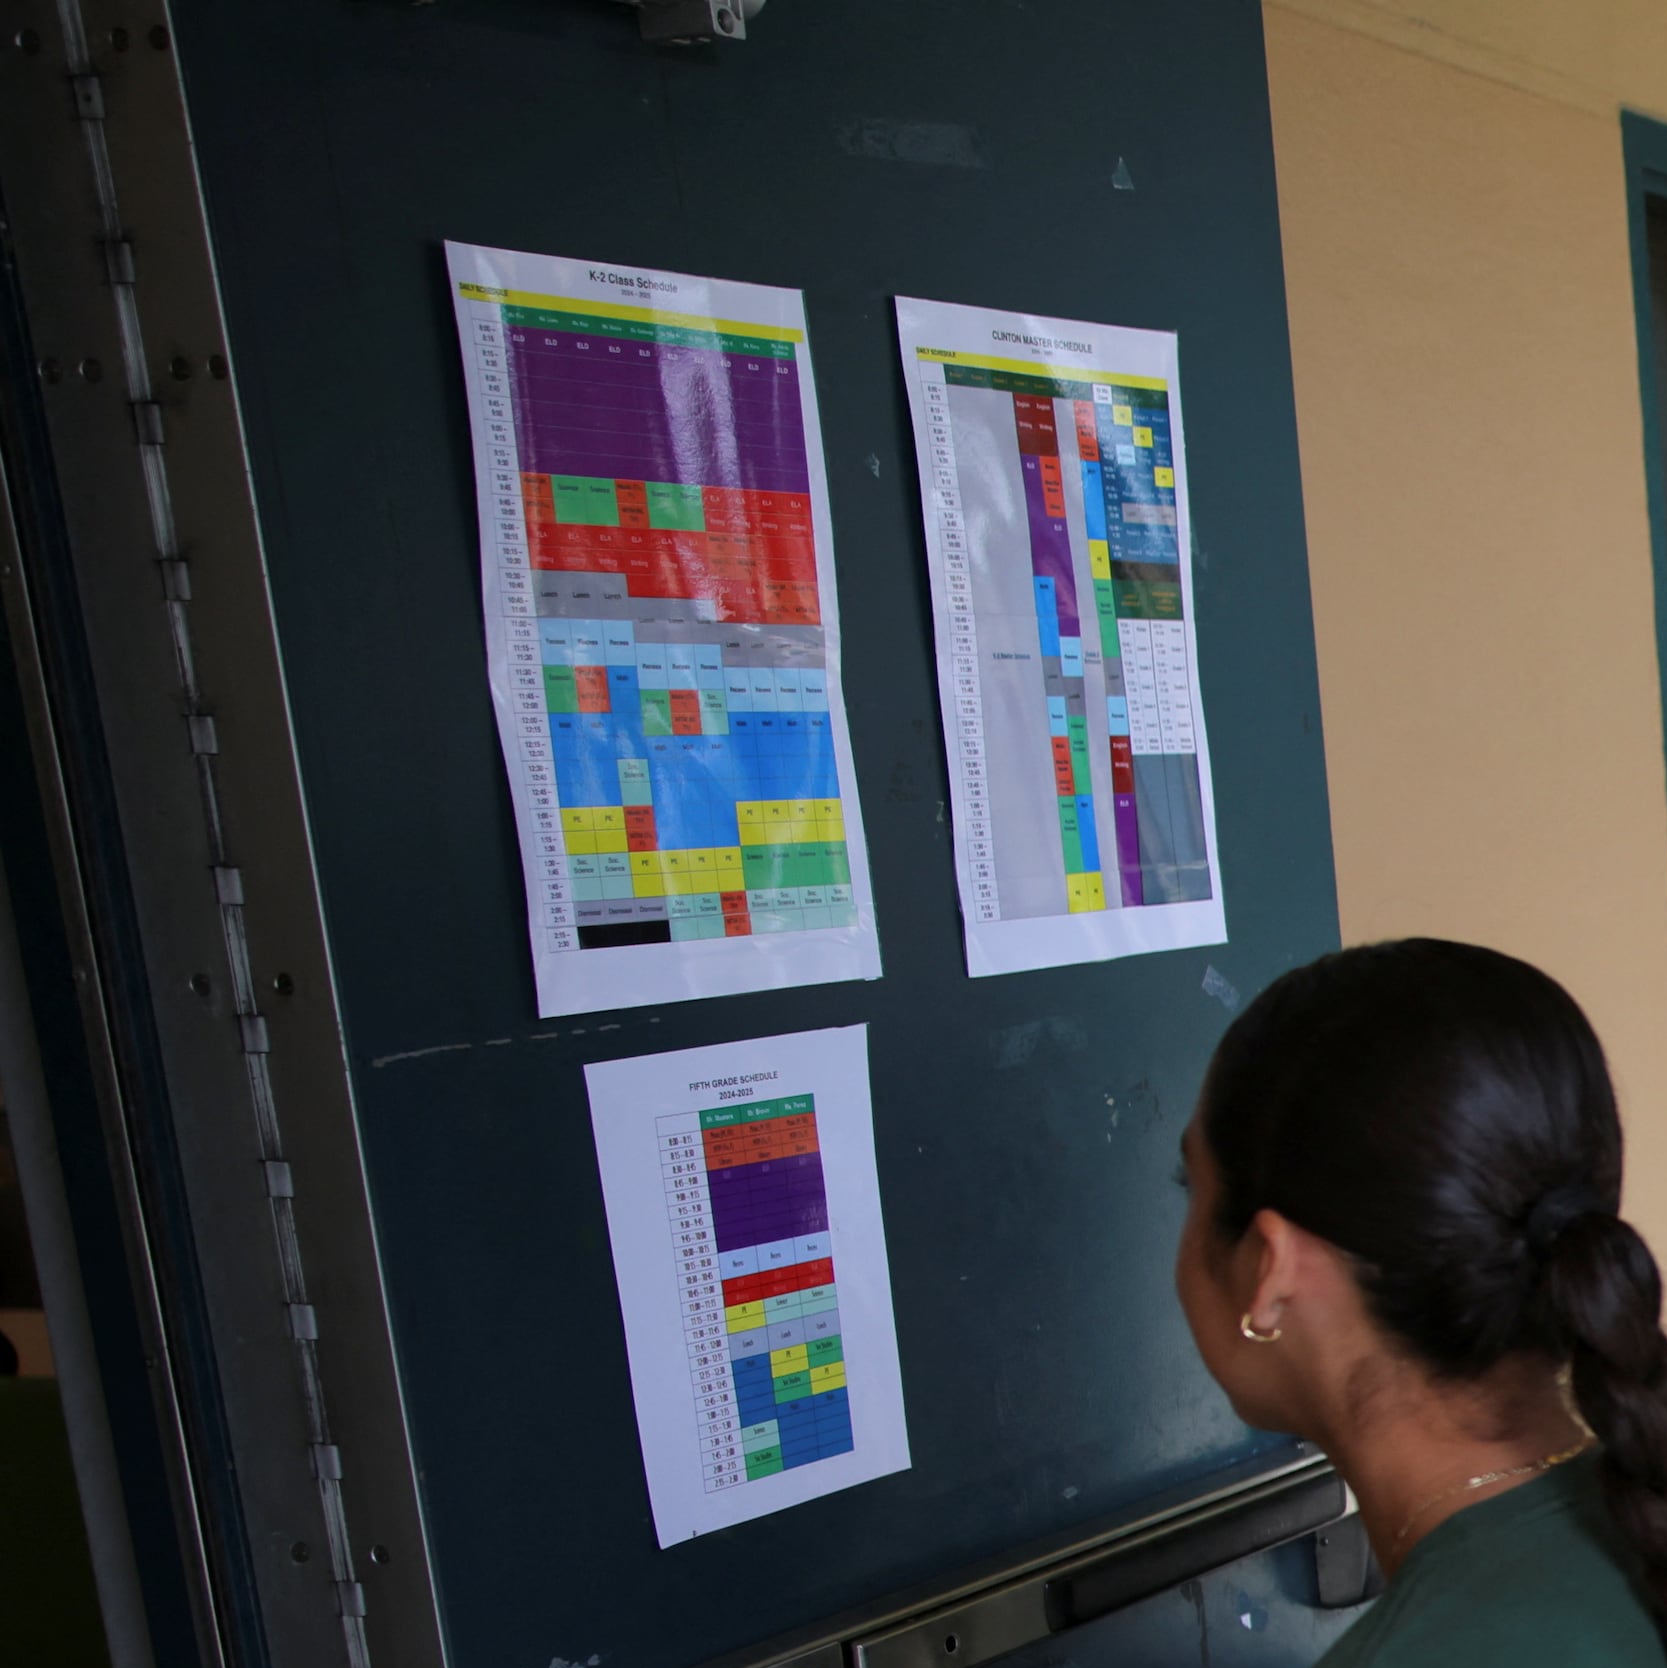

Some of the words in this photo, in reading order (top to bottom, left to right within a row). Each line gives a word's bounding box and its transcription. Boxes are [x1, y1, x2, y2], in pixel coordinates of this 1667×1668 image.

[459, 281, 475, 291] DAILY
[589, 270, 606, 283] K-2
[608, 272, 635, 288] Class
[637, 277, 678, 294] Schedule
[992, 330, 1022, 344] CLINTON
[1022, 335, 1053, 348] MASTER
[1054, 339, 1093, 354] SCHEDULE
[513, 334, 525, 343] ELD
[545, 338, 558, 347] ELD
[577, 342, 590, 350] ELD
[608, 345, 621, 354] ELD
[639, 349, 651, 358] ELD
[667, 353, 678, 361] ELD
[720, 360, 732, 368] ELD
[748, 363, 759, 372] ELD
[777, 366, 789, 375] ELD
[916, 347, 930, 356] DAILY
[931, 349, 956, 358] SCHEDULE
[1036, 403, 1050, 411] English
[689, 1081, 711, 1092] FIFTH
[712, 1076, 739, 1088] GRADE
[739, 1070, 779, 1084] SCHEDULE
[719, 1088, 754, 1100] 2024-2025
